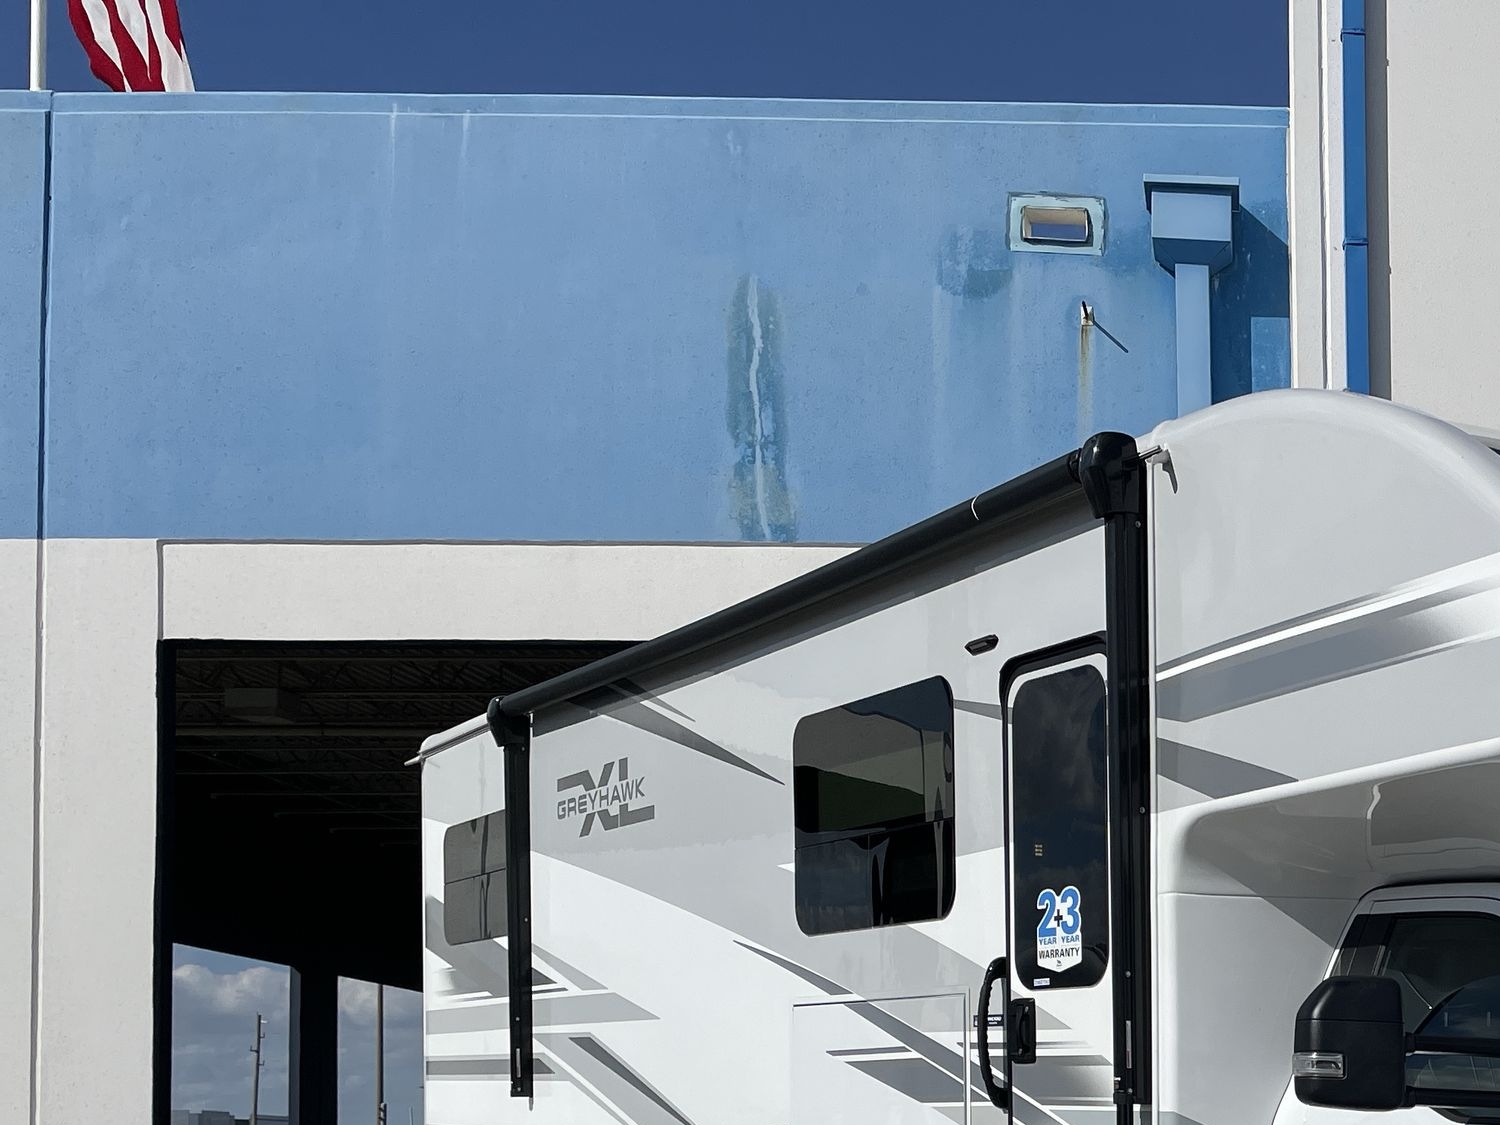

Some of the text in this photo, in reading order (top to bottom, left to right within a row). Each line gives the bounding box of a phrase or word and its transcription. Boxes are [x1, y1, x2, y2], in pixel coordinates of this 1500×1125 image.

[556, 756, 655, 838] XL
[556, 776, 646, 820] GREYHAWK
[1038, 934, 1080, 946] YEAR YEAR
[1038, 946, 1080, 960] WARRANTY
